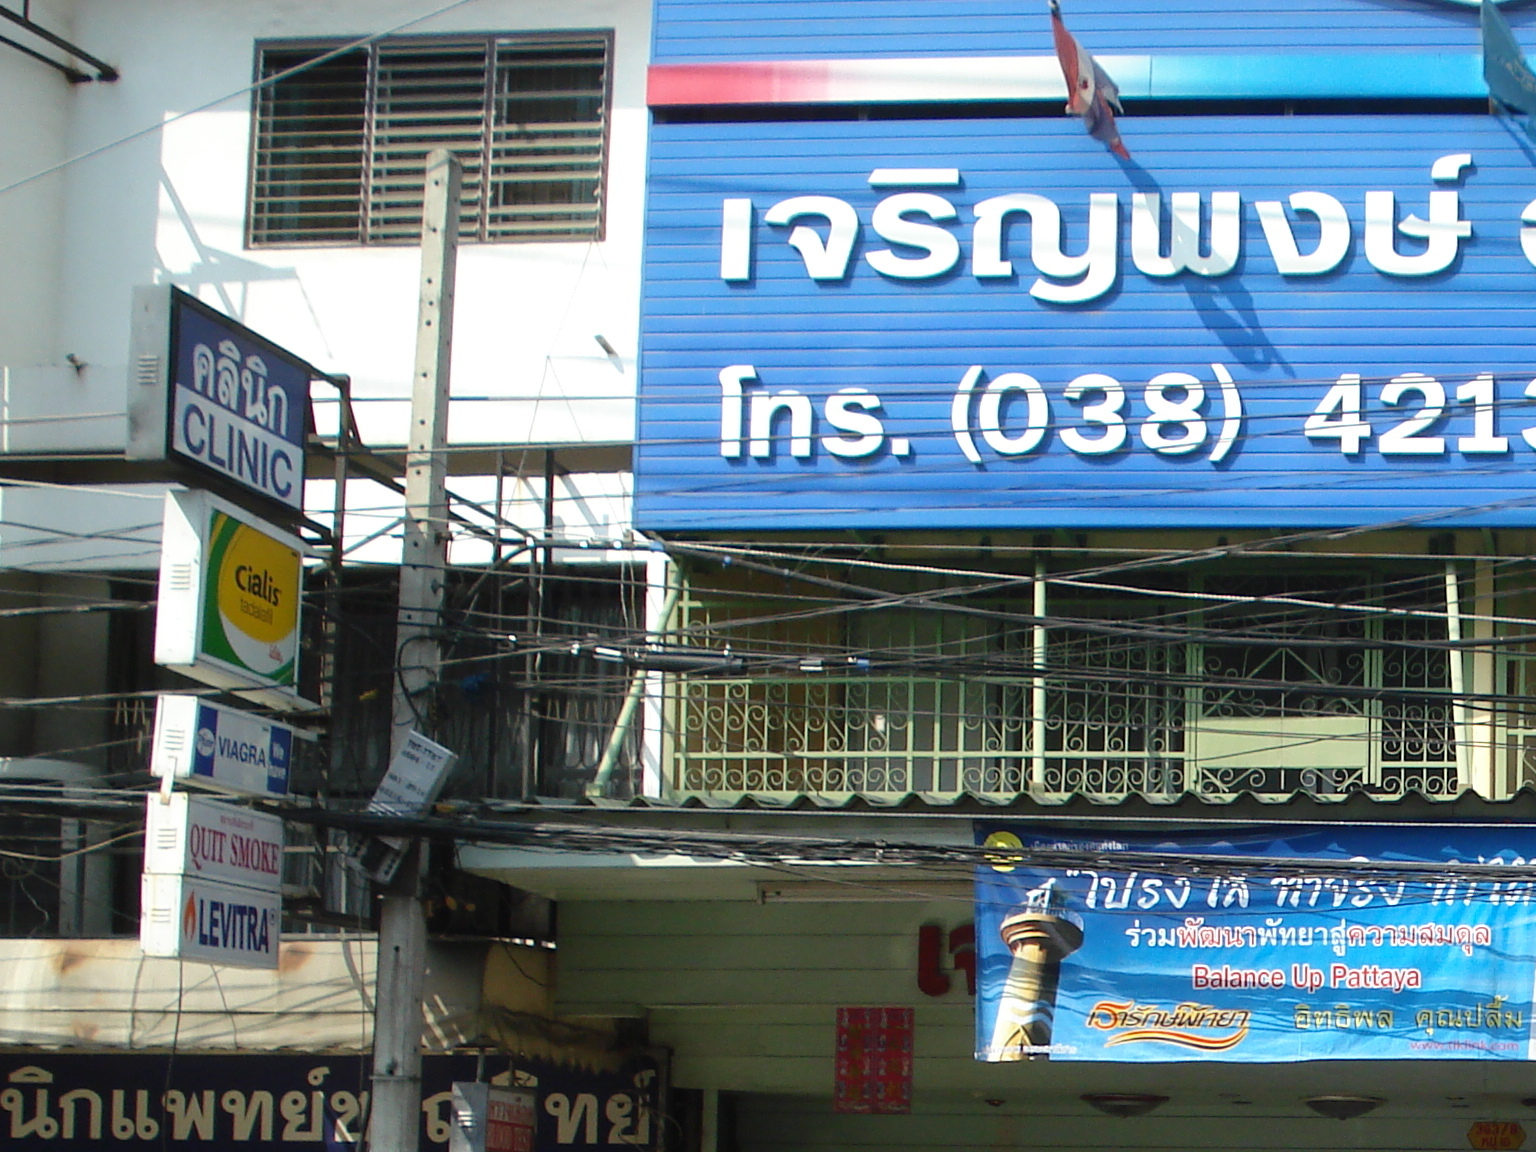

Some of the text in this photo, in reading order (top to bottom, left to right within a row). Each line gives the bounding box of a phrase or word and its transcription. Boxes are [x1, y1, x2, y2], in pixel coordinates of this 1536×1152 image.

[720, 153, 1474, 305] เจริญพงษ์
[193, 338, 289, 436] คลินิก
[718, 364, 912, 459] โทร.
[950, 362, 1243, 466] (038)
[182, 402, 293, 499] CLINIC
[234, 564, 282, 607] Cialis
[218, 735, 267, 768] VIAGRA
[189, 823, 280, 875] QUIT SMOKE
[199, 898, 270, 954] LEVITRA
[1192, 965, 1421, 993] Balance Up Pattaya
[1293, 995, 1523, 1036] อิทธิพล คุณปลื้ม
